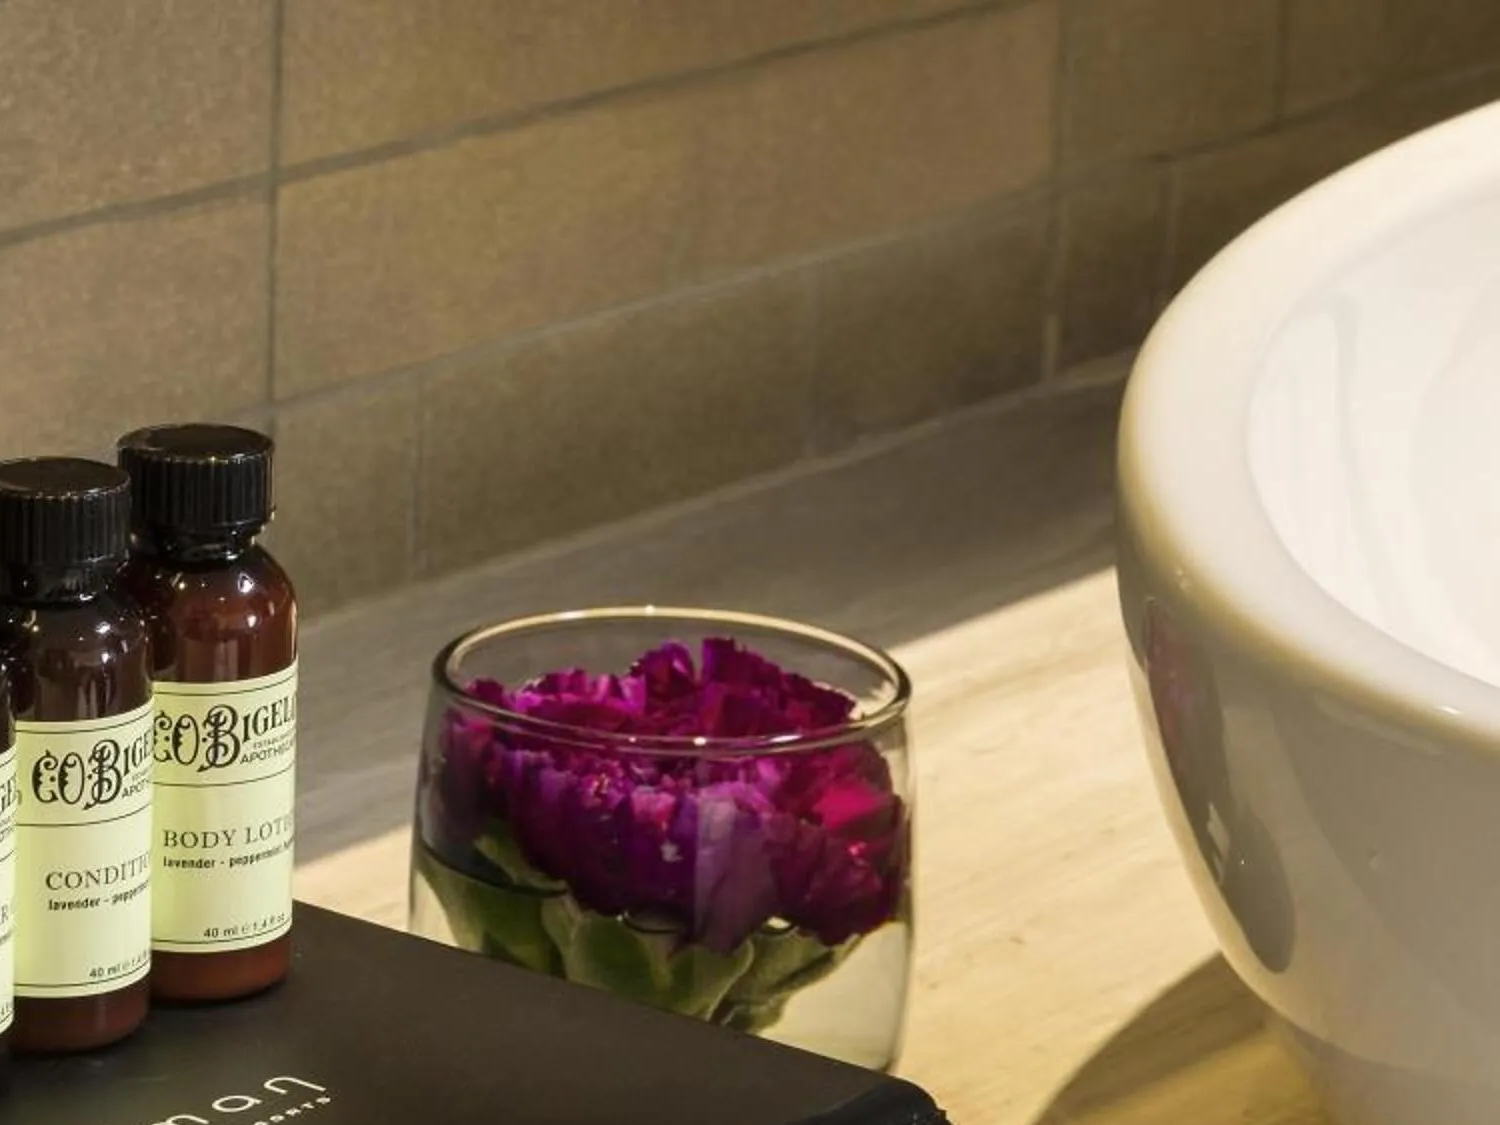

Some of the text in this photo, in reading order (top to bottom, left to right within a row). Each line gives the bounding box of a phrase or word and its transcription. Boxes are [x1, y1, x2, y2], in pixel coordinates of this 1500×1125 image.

[164, 829, 237, 849] BODY
[163, 856, 216, 869] lavender
[48, 896, 101, 911] lavender
[203, 926, 219, 938] 40
[223, 925, 239, 937] ml
[89, 967, 104, 978] 40
